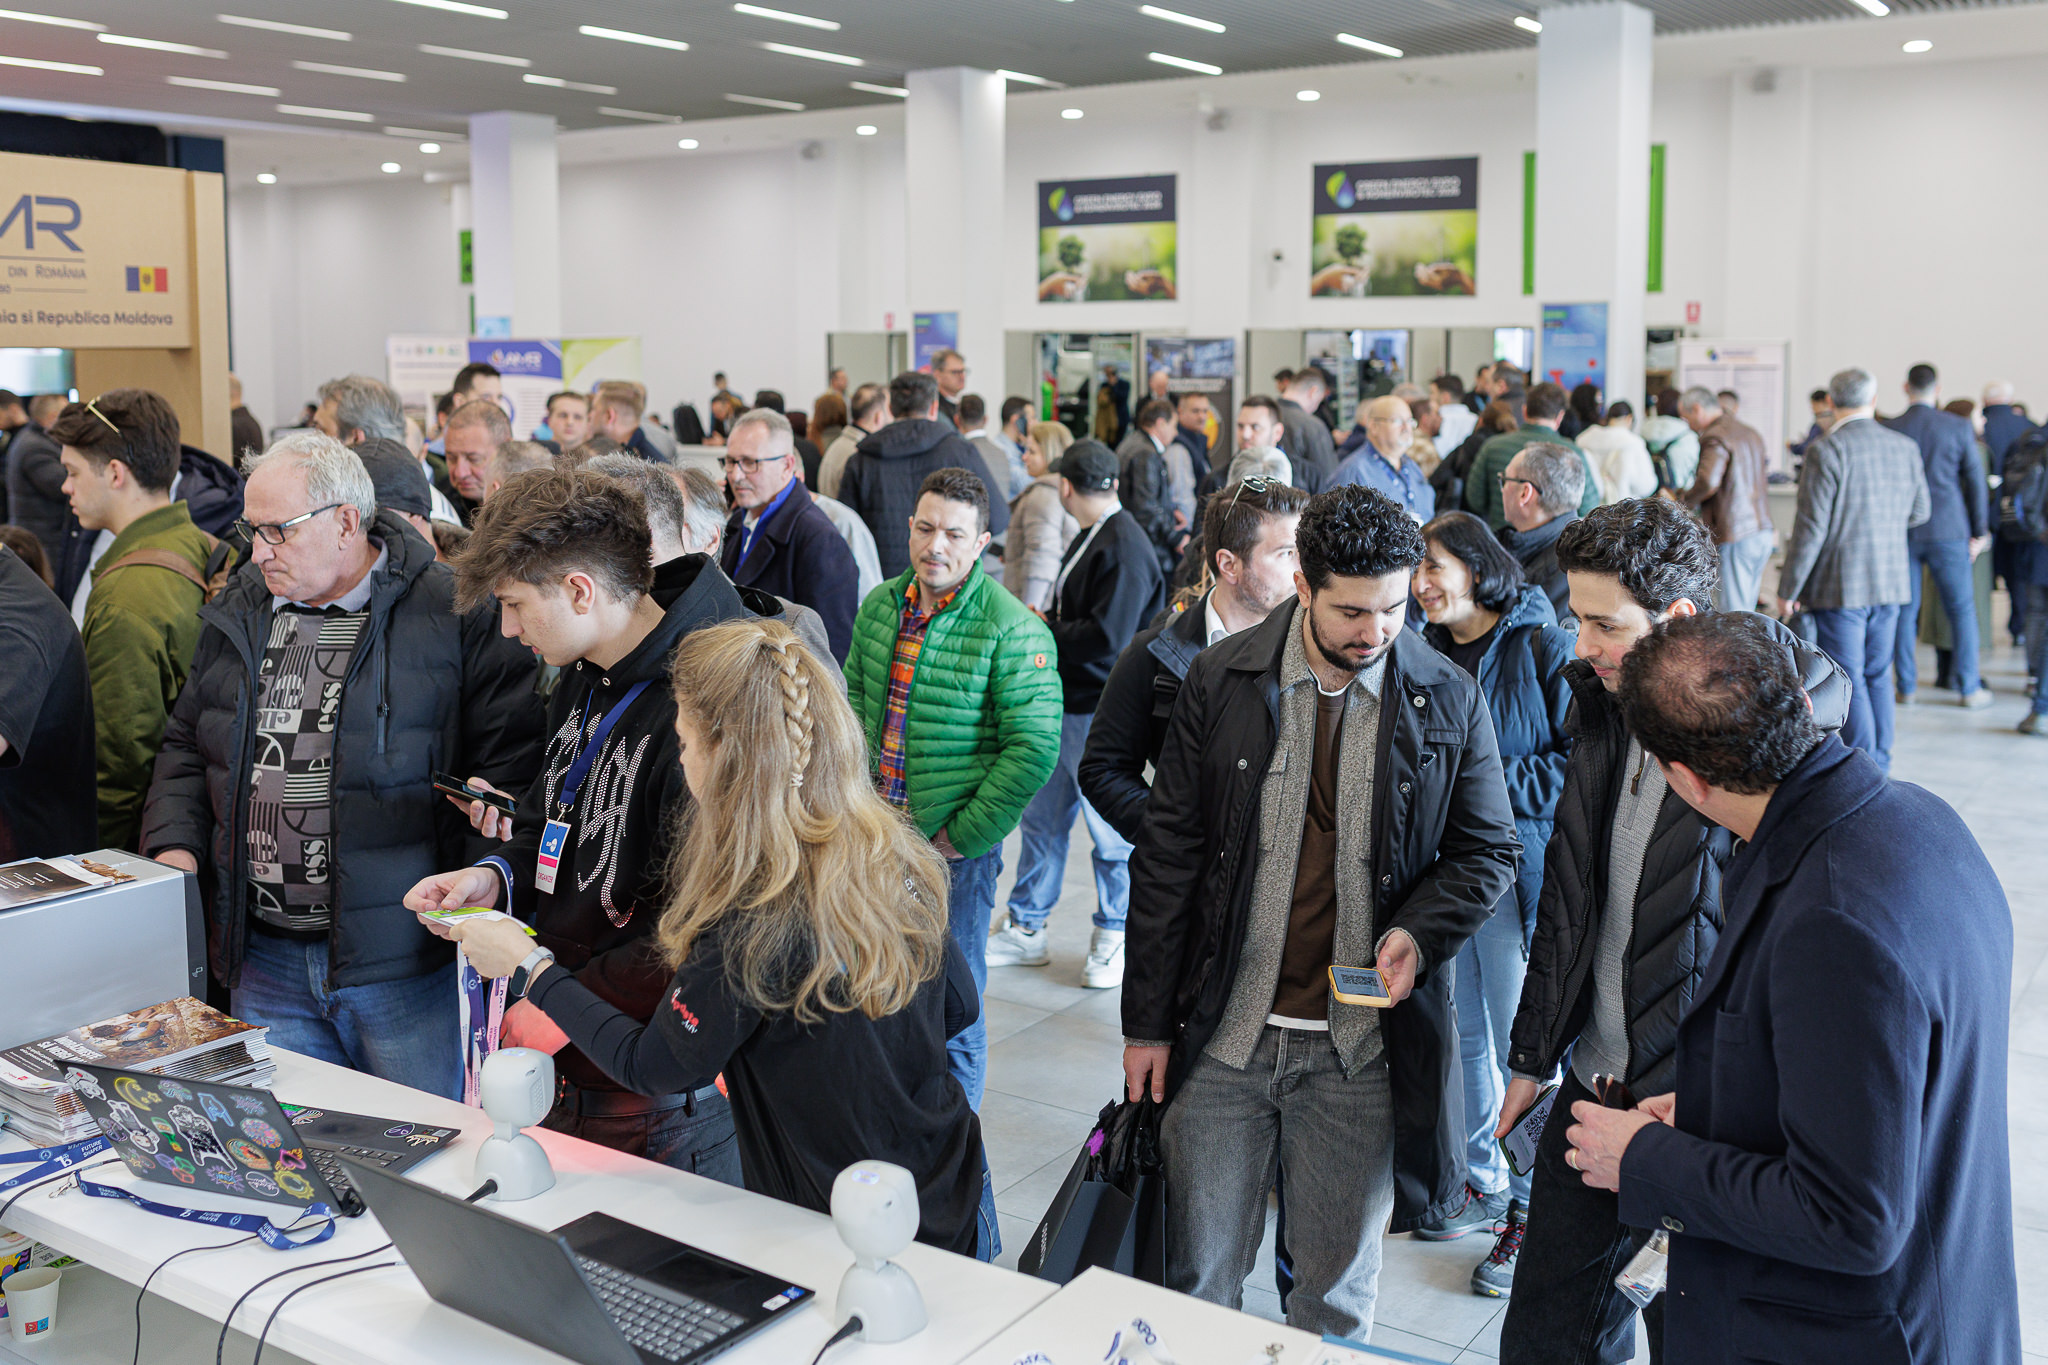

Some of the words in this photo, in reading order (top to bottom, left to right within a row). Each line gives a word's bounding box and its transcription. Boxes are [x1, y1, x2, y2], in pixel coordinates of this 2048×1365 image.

[1355, 178, 1389, 191] GREEN
[8, 266, 28, 278] DIN
[21, 309, 33, 325] si
[37, 310, 110, 327] Republica
[114, 311, 173, 326] Moldova
[81, 1140, 102, 1152] FUTURE
[83, 1145, 103, 1158] SHAPER
